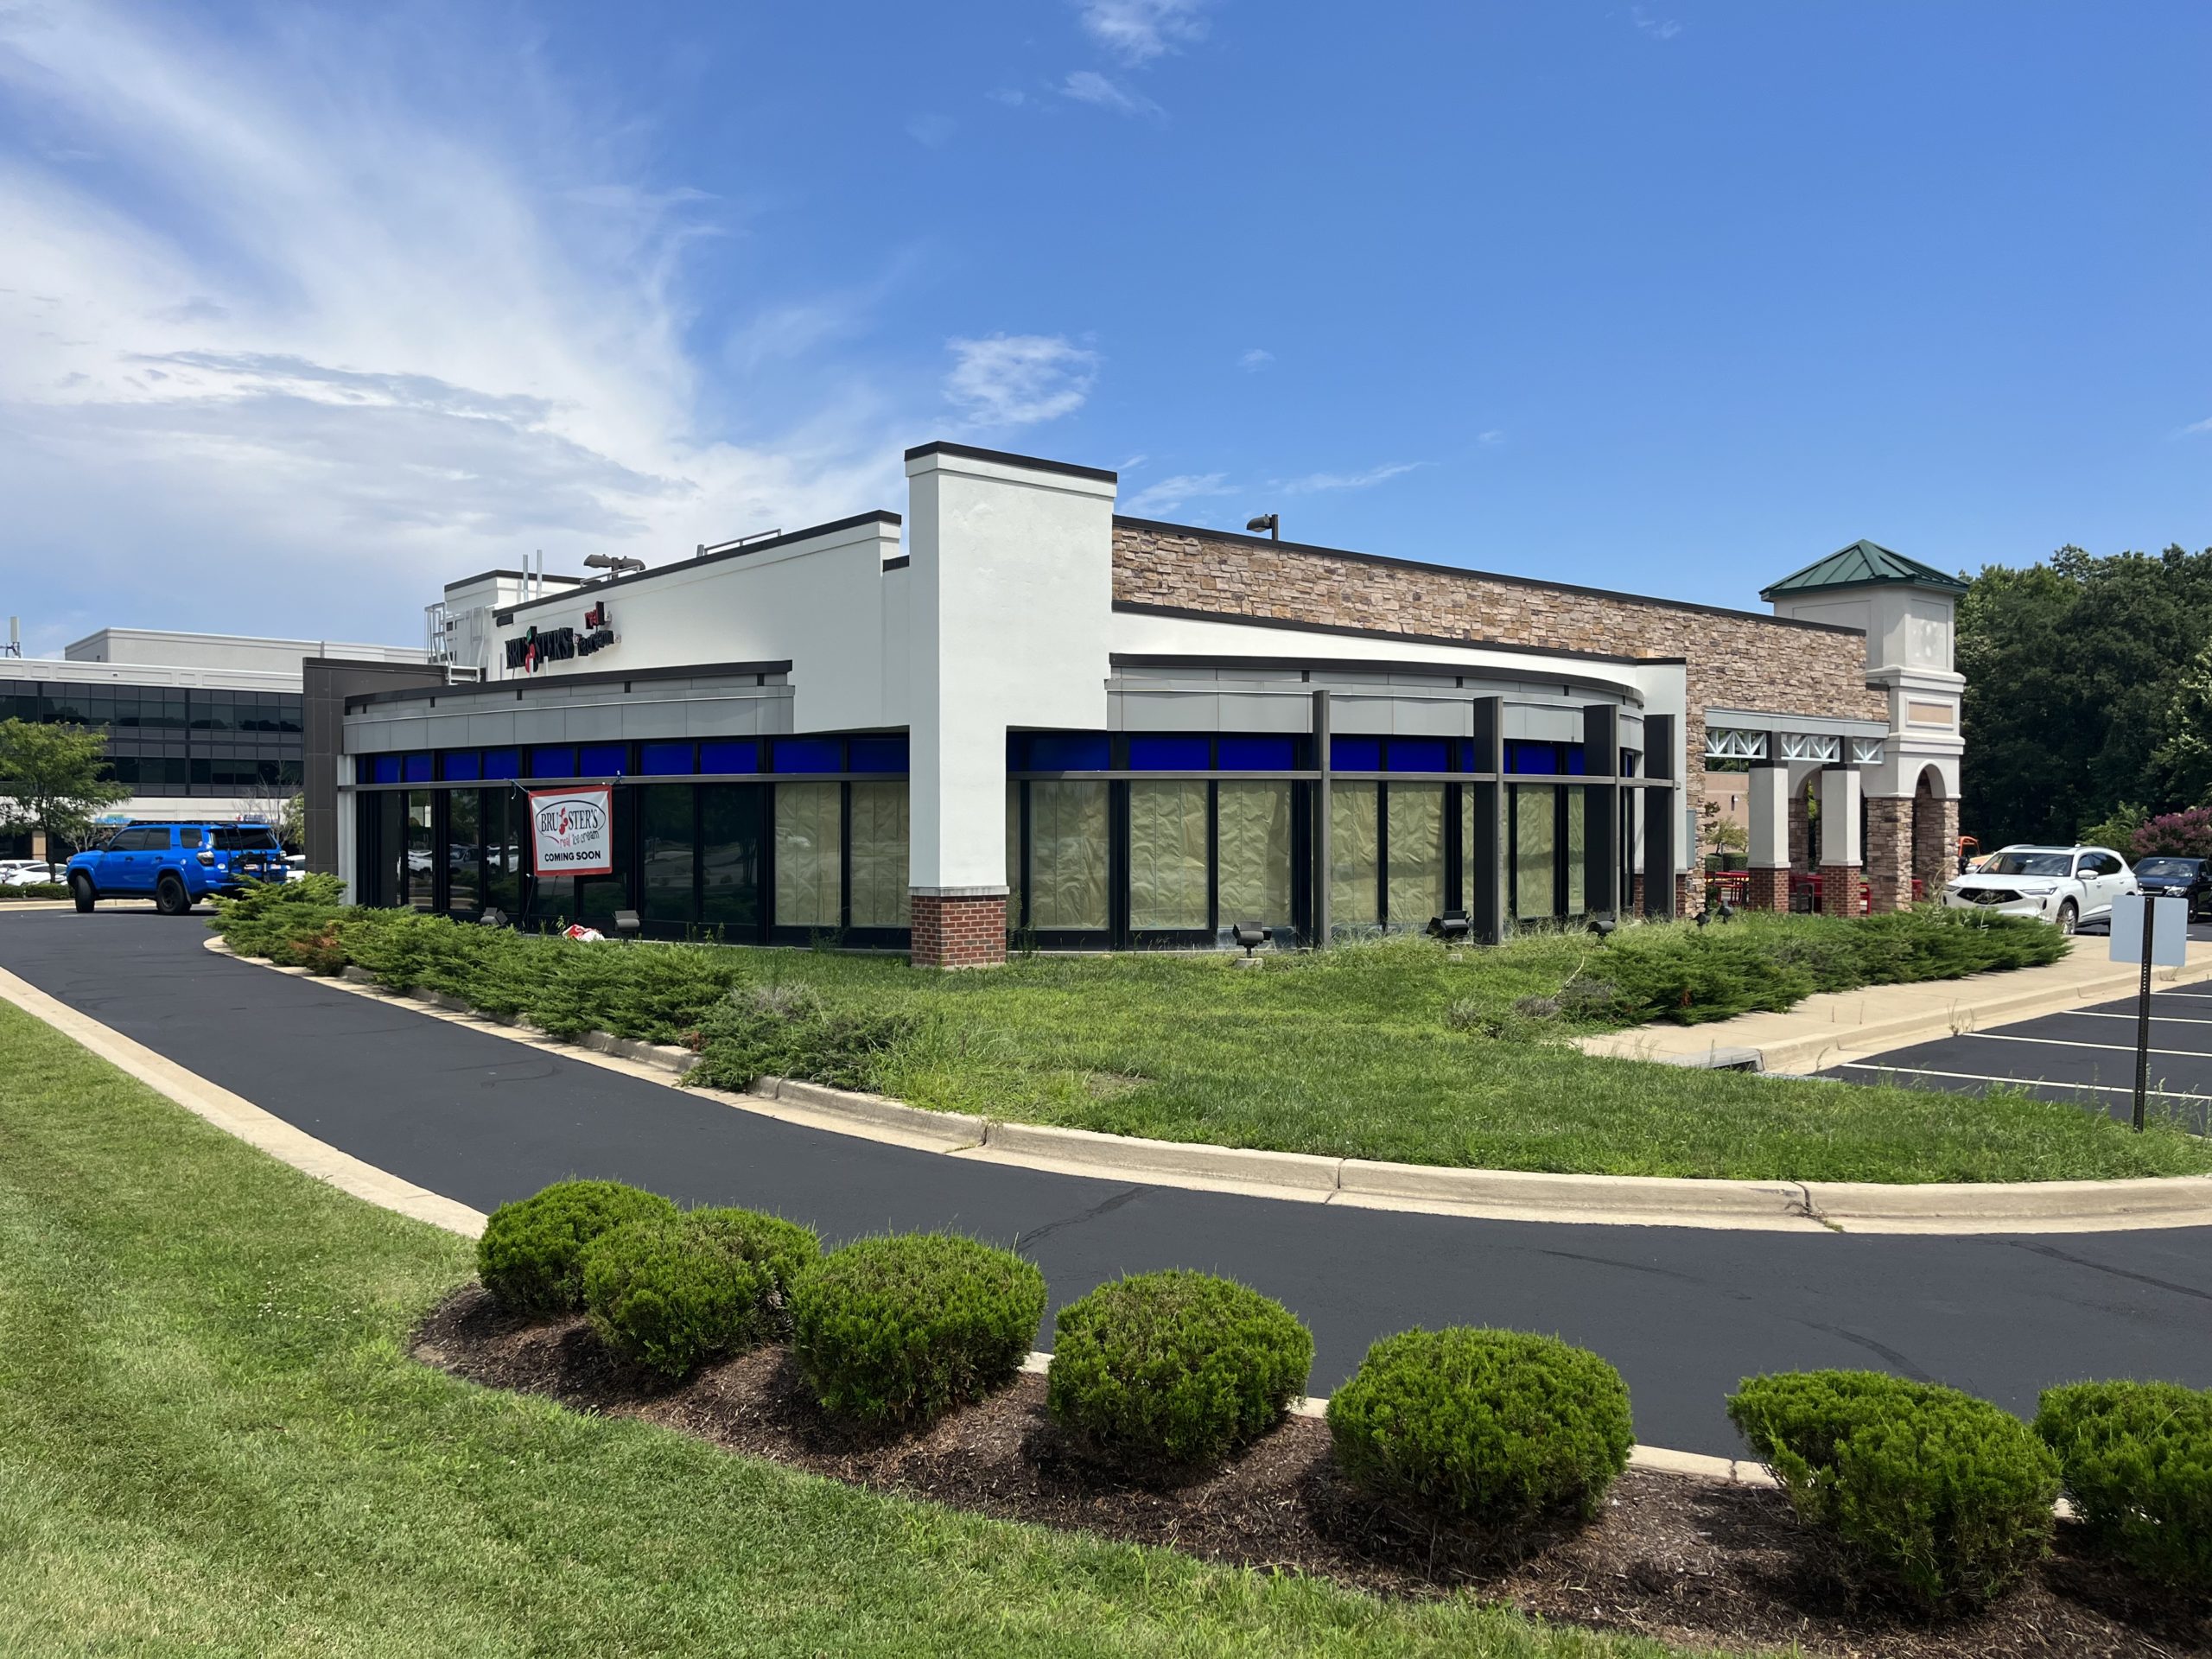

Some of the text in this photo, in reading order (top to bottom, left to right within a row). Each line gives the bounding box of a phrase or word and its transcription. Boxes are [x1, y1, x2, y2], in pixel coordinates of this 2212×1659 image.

[580, 830, 600, 843] cream
[544, 850, 601, 862] COMING SOON
